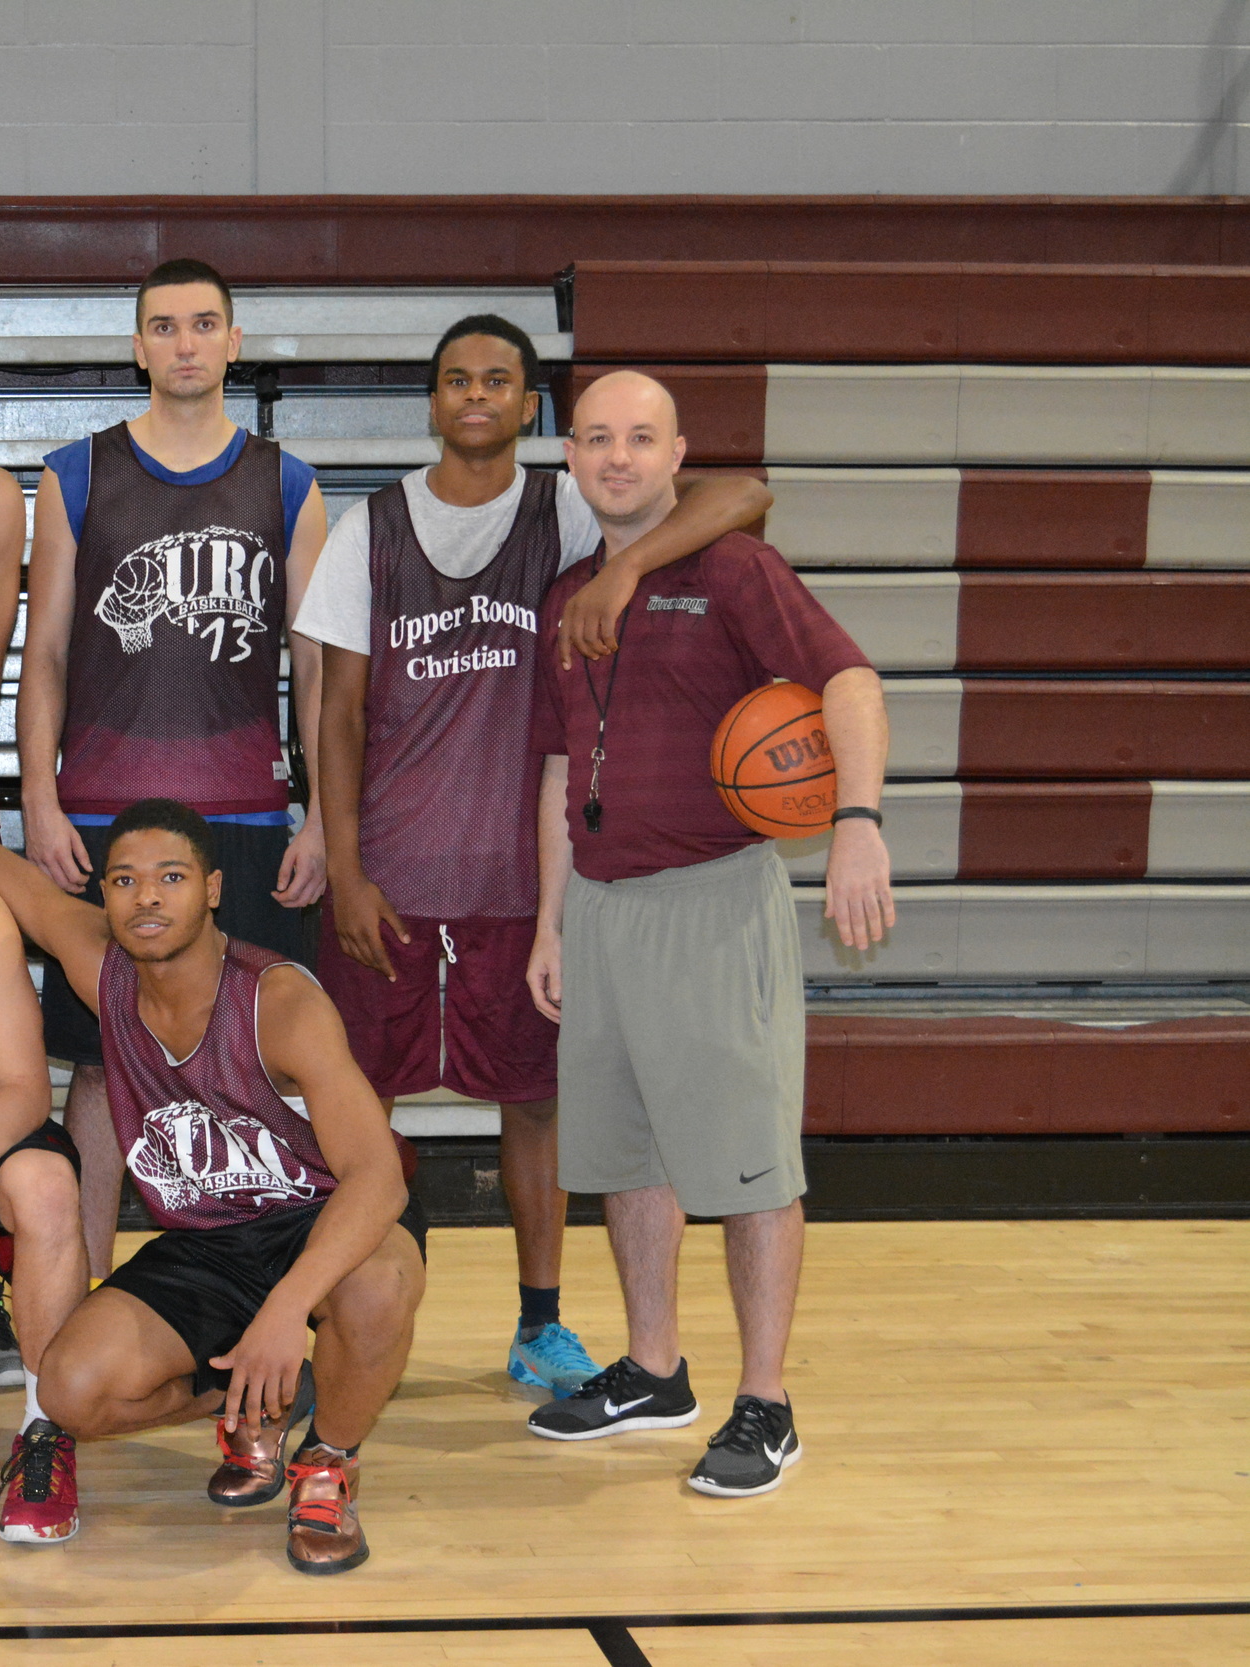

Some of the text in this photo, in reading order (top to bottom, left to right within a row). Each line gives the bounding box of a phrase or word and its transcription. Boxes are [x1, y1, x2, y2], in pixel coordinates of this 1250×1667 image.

[164, 540, 274, 611] URC
[178, 597, 261, 620] BASKETBALL
[390, 595, 538, 650] Upper Room
[406, 645, 517, 681] Christian
[764, 729, 831, 772] Wil
